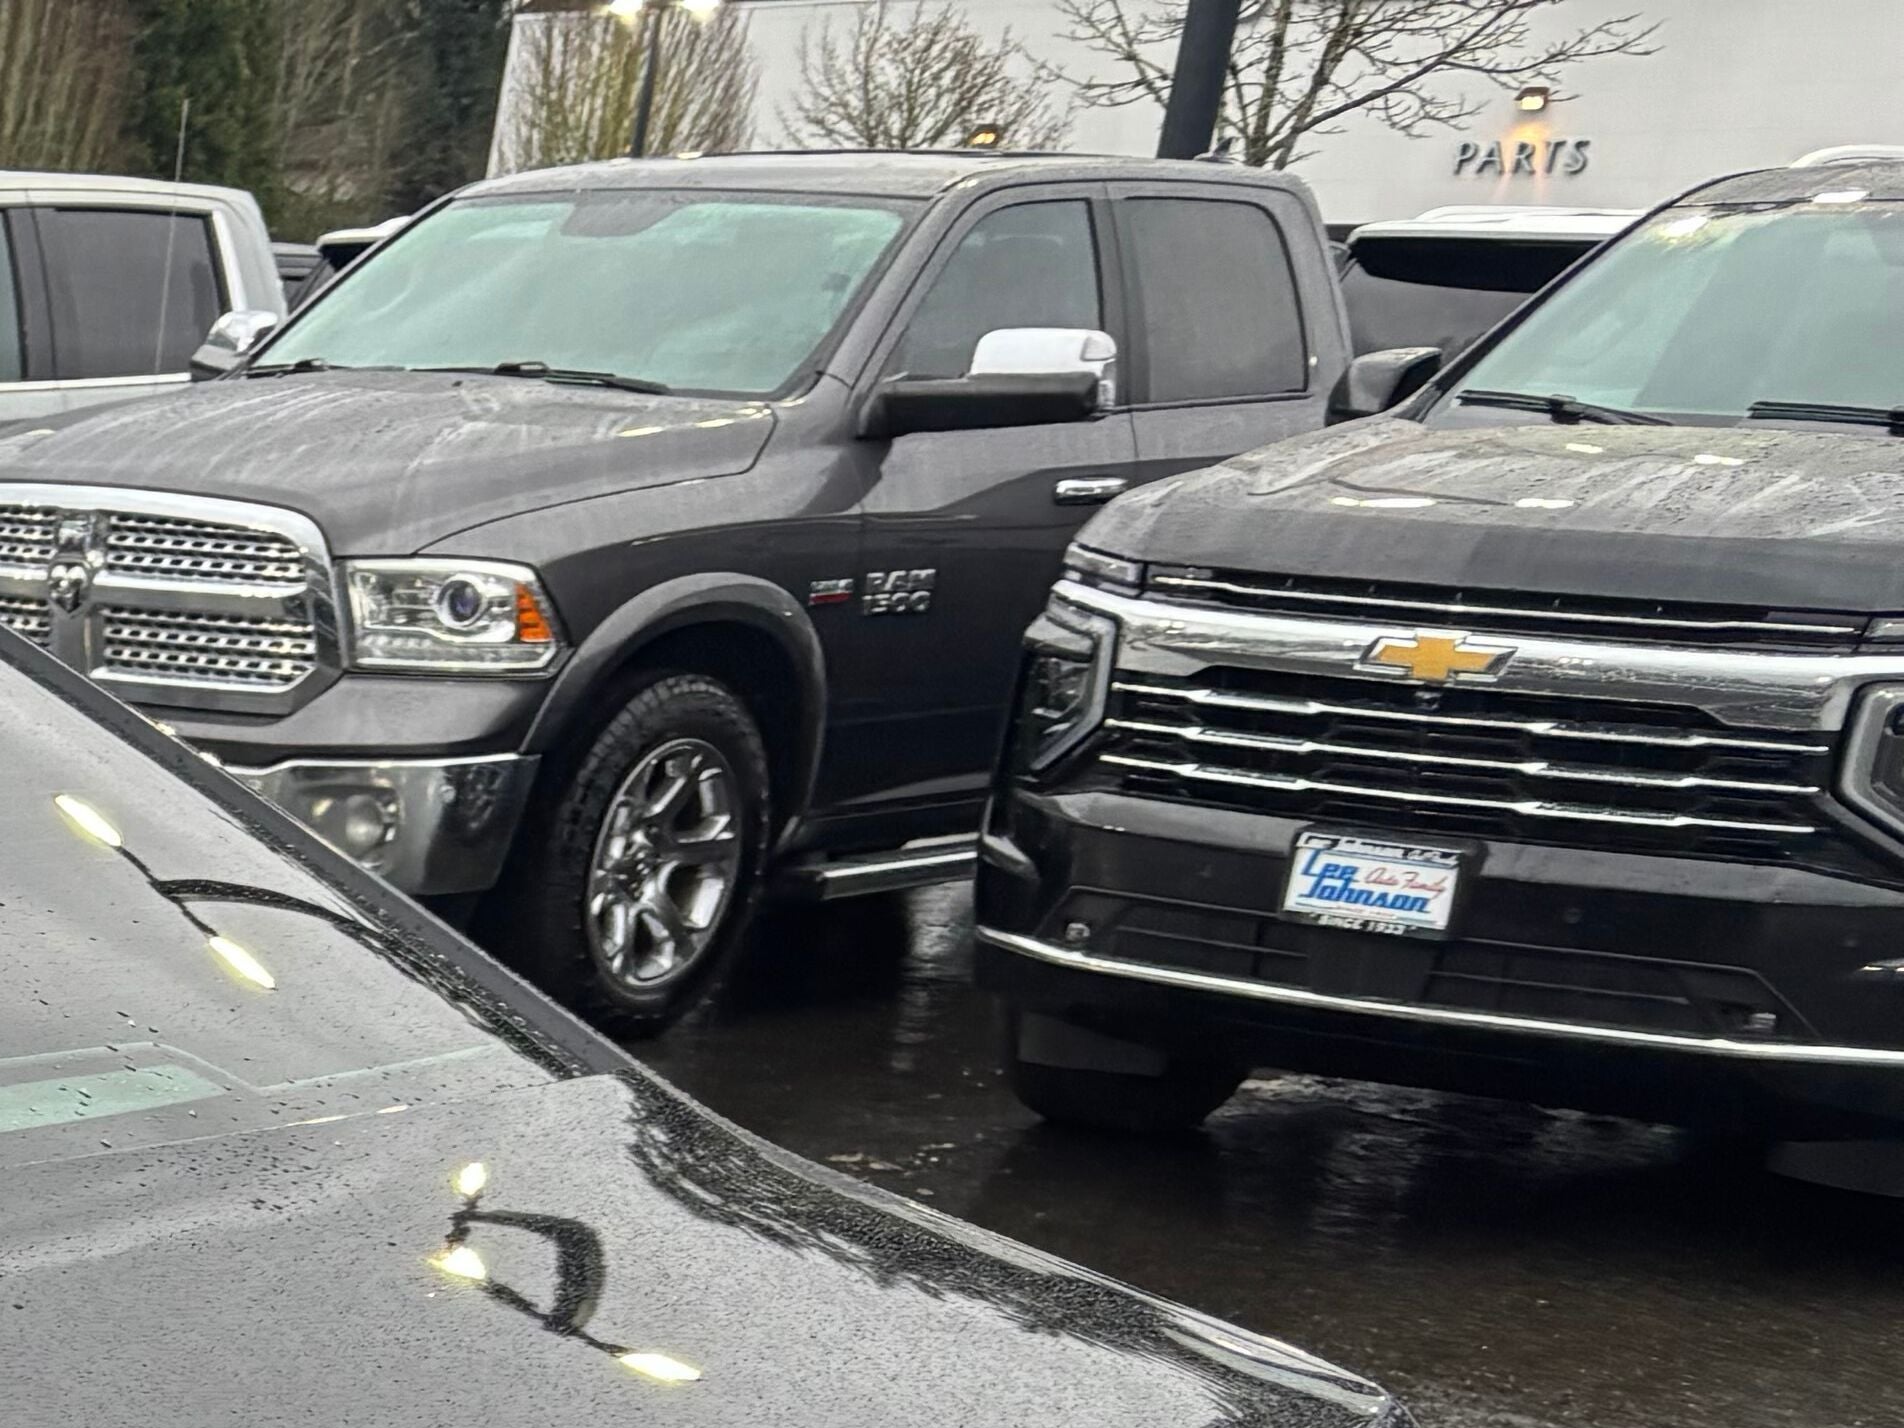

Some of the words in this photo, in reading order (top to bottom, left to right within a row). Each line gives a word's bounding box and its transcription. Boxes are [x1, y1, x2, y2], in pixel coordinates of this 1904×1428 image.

[1453, 140, 1591, 175] PARTS
[1301, 849, 1359, 881] Lee
[1298, 872, 1431, 913] Johnson
